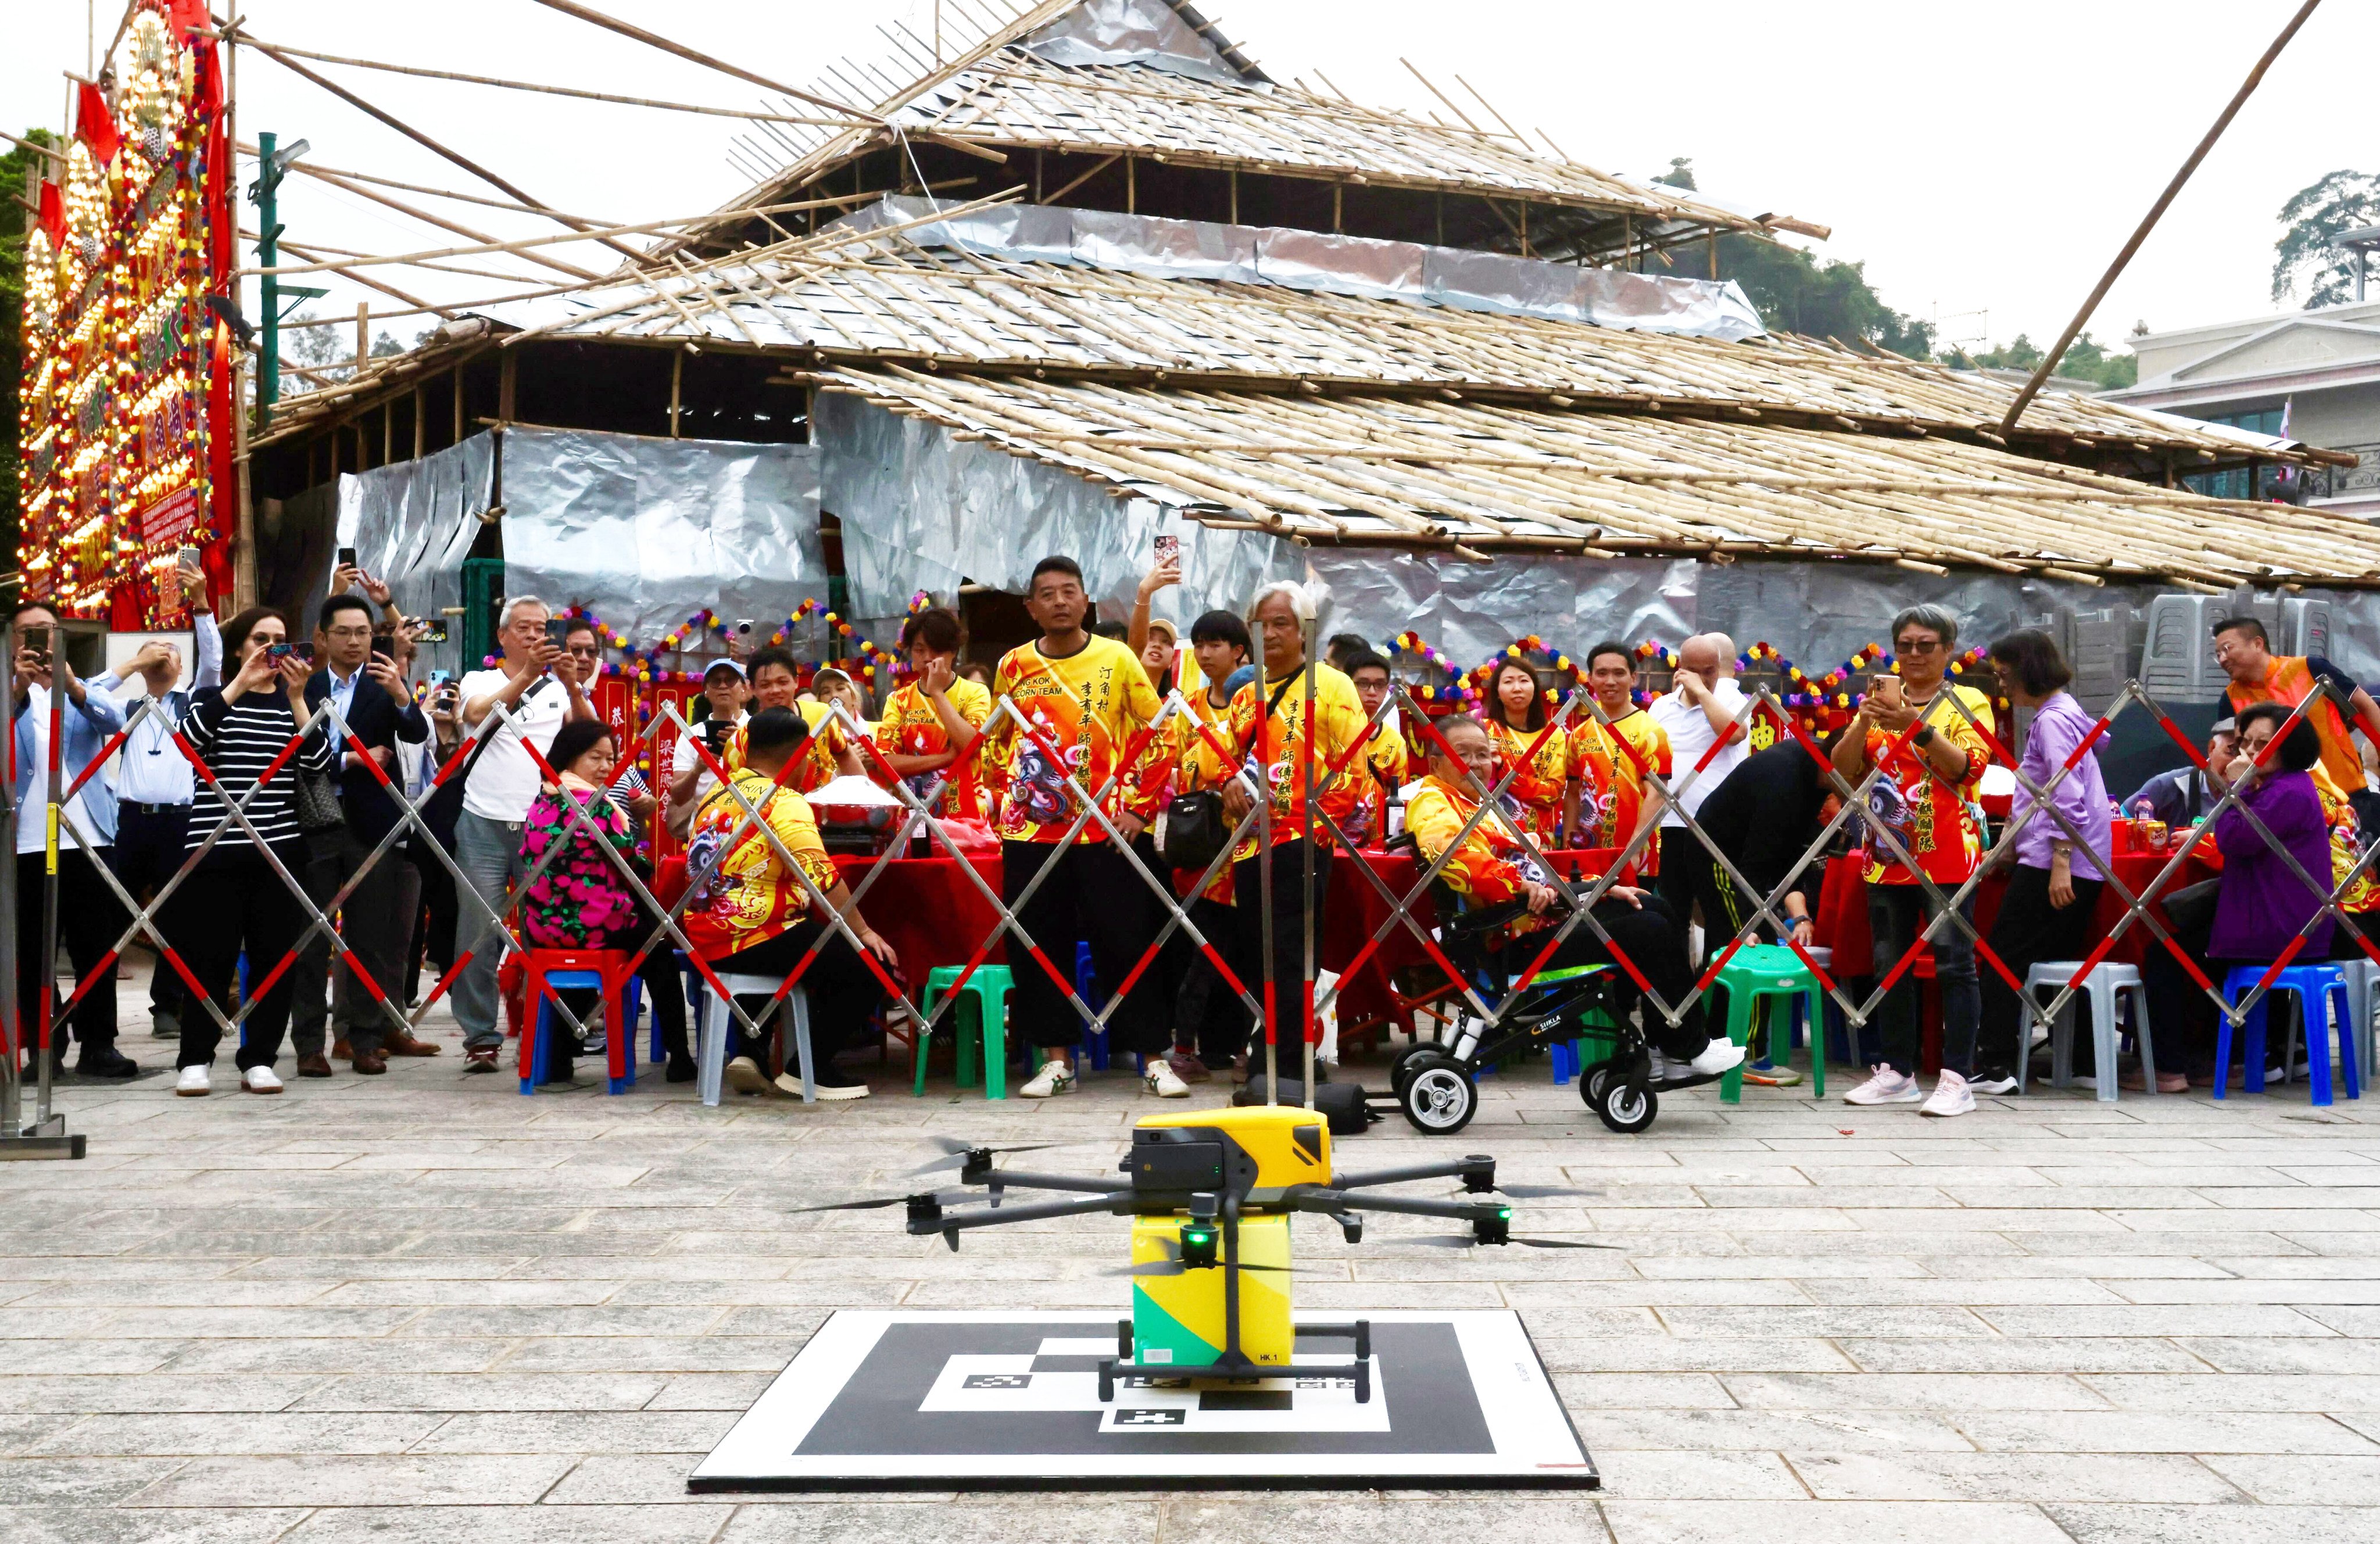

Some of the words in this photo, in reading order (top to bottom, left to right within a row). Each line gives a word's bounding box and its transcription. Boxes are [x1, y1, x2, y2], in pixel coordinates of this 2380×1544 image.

[1033, 677, 1050, 685] KOK
[1039, 687, 1062, 696] TEAM
[1096, 666, 1113, 713] 汀角村
